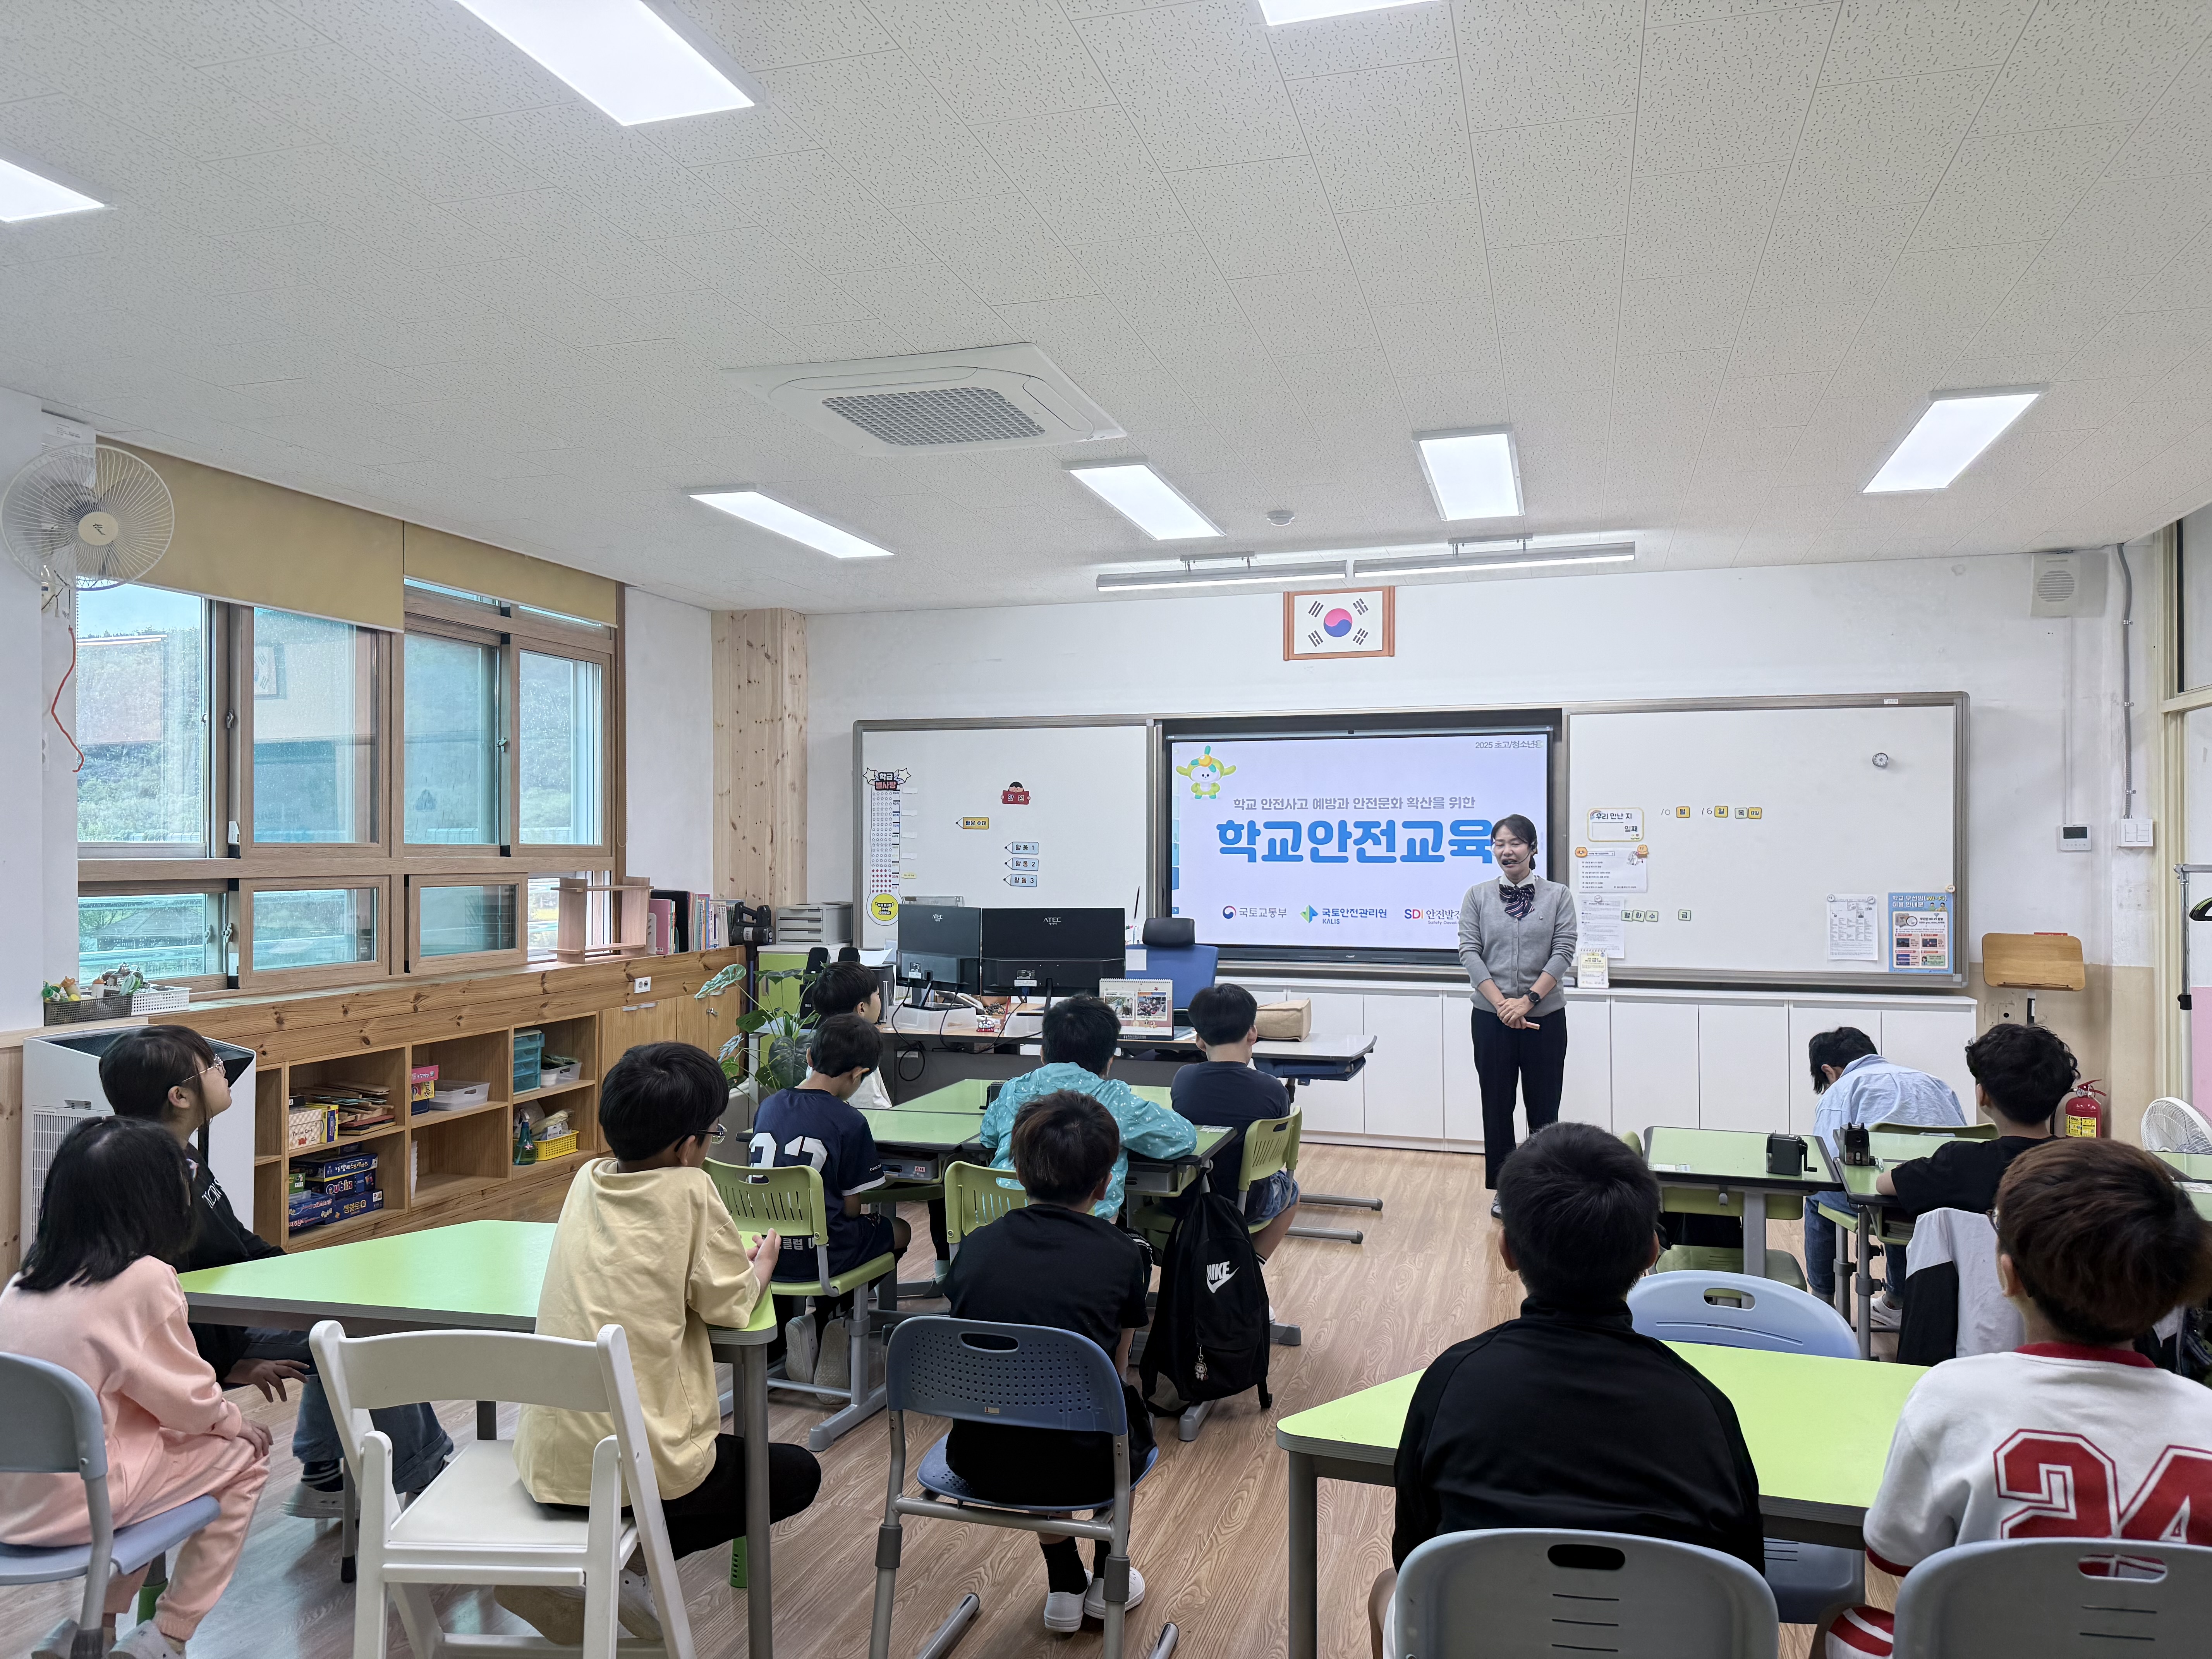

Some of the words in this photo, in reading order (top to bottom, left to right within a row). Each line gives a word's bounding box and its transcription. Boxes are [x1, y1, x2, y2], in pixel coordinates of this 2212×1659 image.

[875, 781, 896, 790] 별사탕
[1233, 798, 1257, 811] 학교
[1261, 798, 1309, 810] 안전사고
[1312, 798, 1349, 810] 예방과
[1353, 797, 1403, 809] 안전문화
[1407, 797, 1445, 809] 확산을
[1449, 797, 1475, 809] 위한
[1702, 807, 1712, 816] 16
[1216, 819, 1492, 864] 학교안전교육
[1239, 907, 1287, 918] 국토교통부
[1322, 908, 1387, 918] 국토안전관리원
[1404, 908, 1424, 919] SDI
[1207, 1261, 1230, 1281] NIKE
